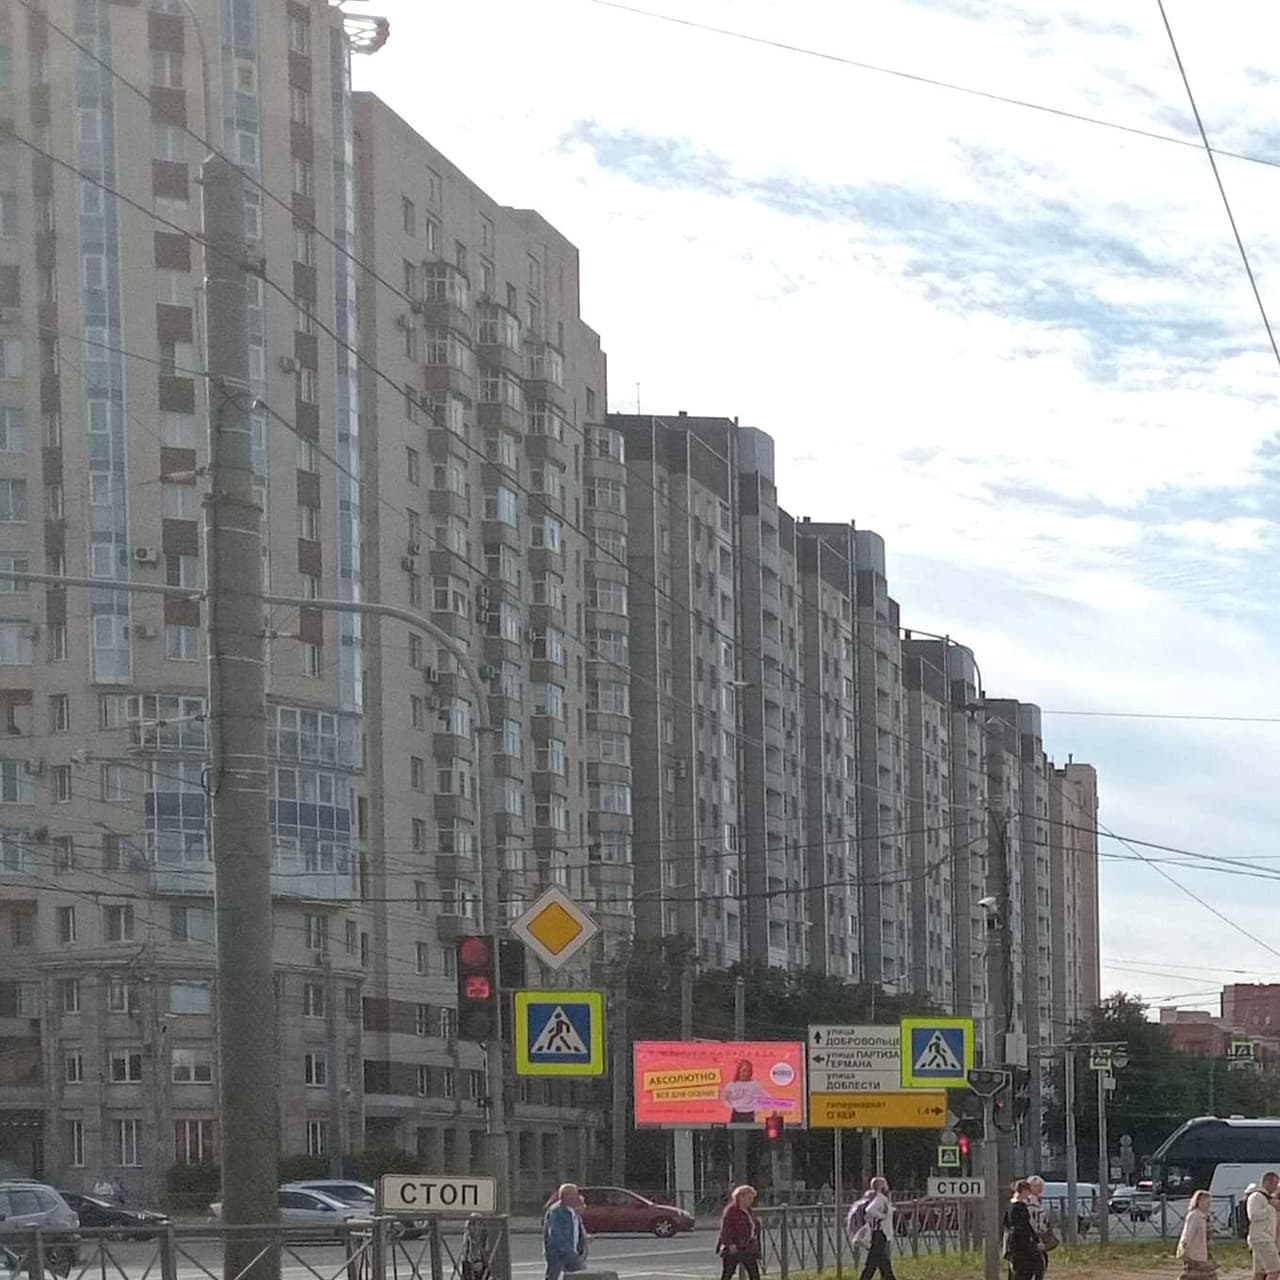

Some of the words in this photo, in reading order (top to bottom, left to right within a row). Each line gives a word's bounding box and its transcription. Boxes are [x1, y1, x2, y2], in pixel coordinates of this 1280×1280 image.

[826, 1060, 872, 1068] ГЕРМАНА
[648, 1071, 716, 1086] АБСОЛЮТНО
[826, 1081, 880, 1090] ДОБЛЕСТИ
[400, 1182, 479, 1206] СТОП
[937, 1181, 981, 1195] СТОП
